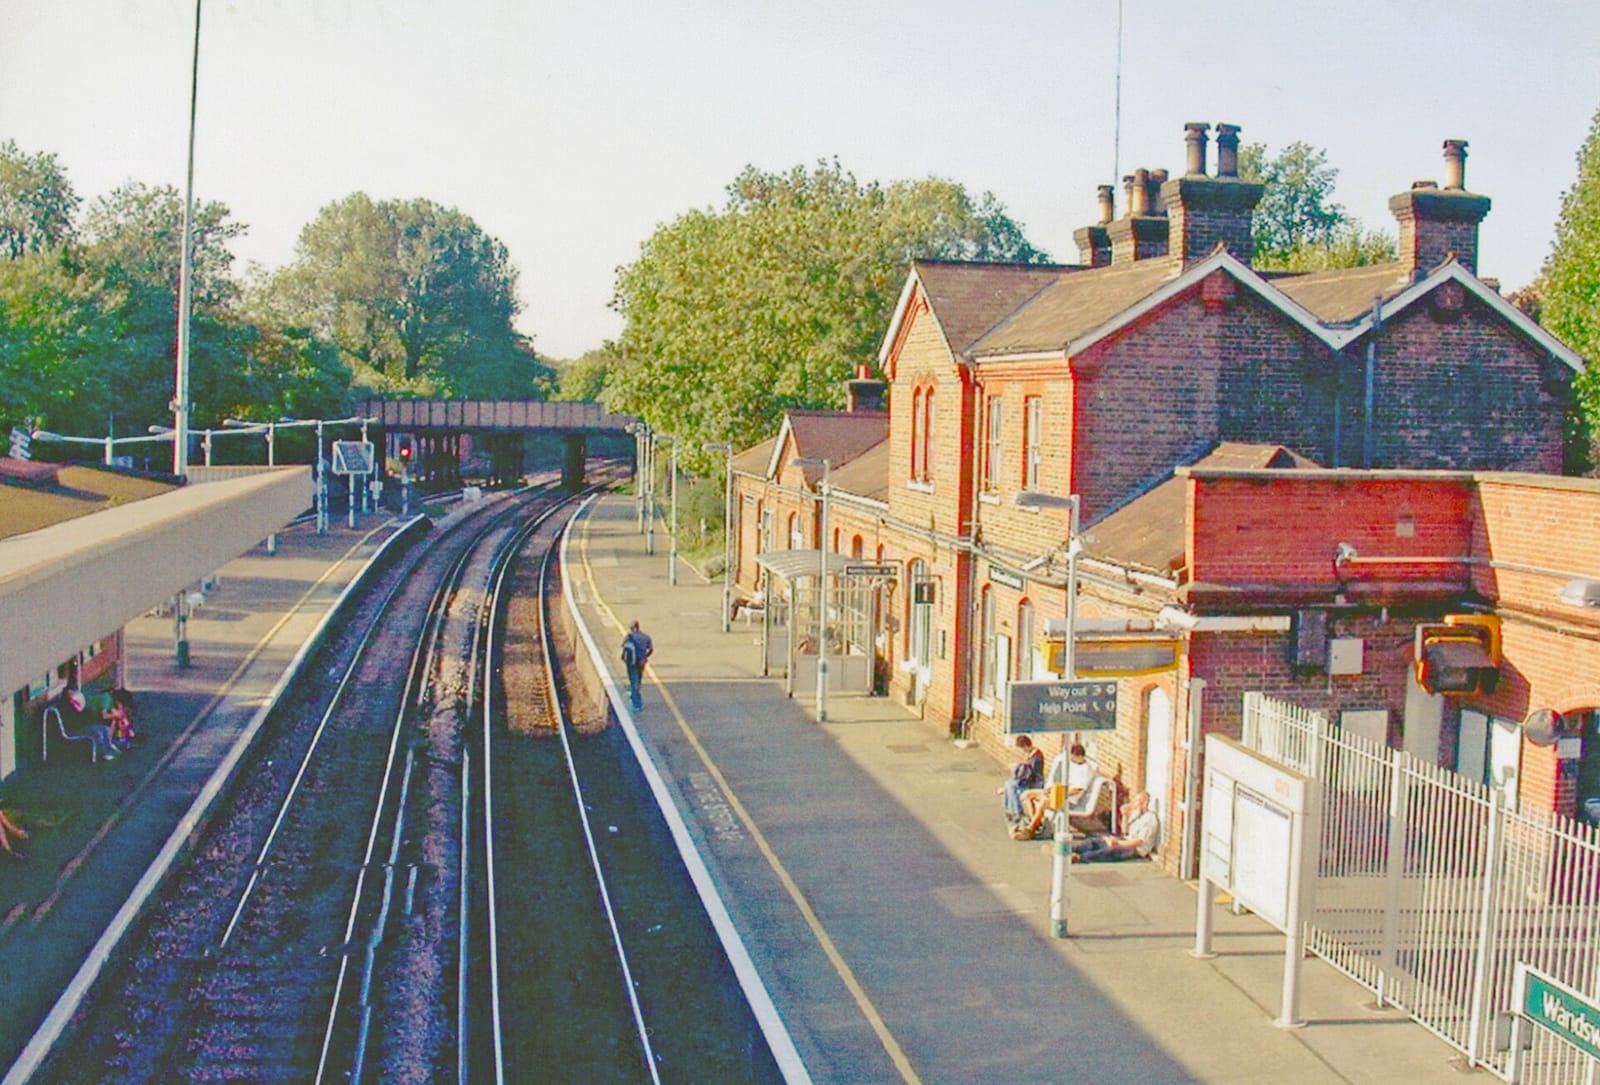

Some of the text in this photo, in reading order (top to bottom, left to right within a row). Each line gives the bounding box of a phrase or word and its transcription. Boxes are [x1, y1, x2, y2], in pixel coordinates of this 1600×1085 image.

[1048, 686, 1088, 699] Way out
[1039, 702, 1088, 714] Help Point
